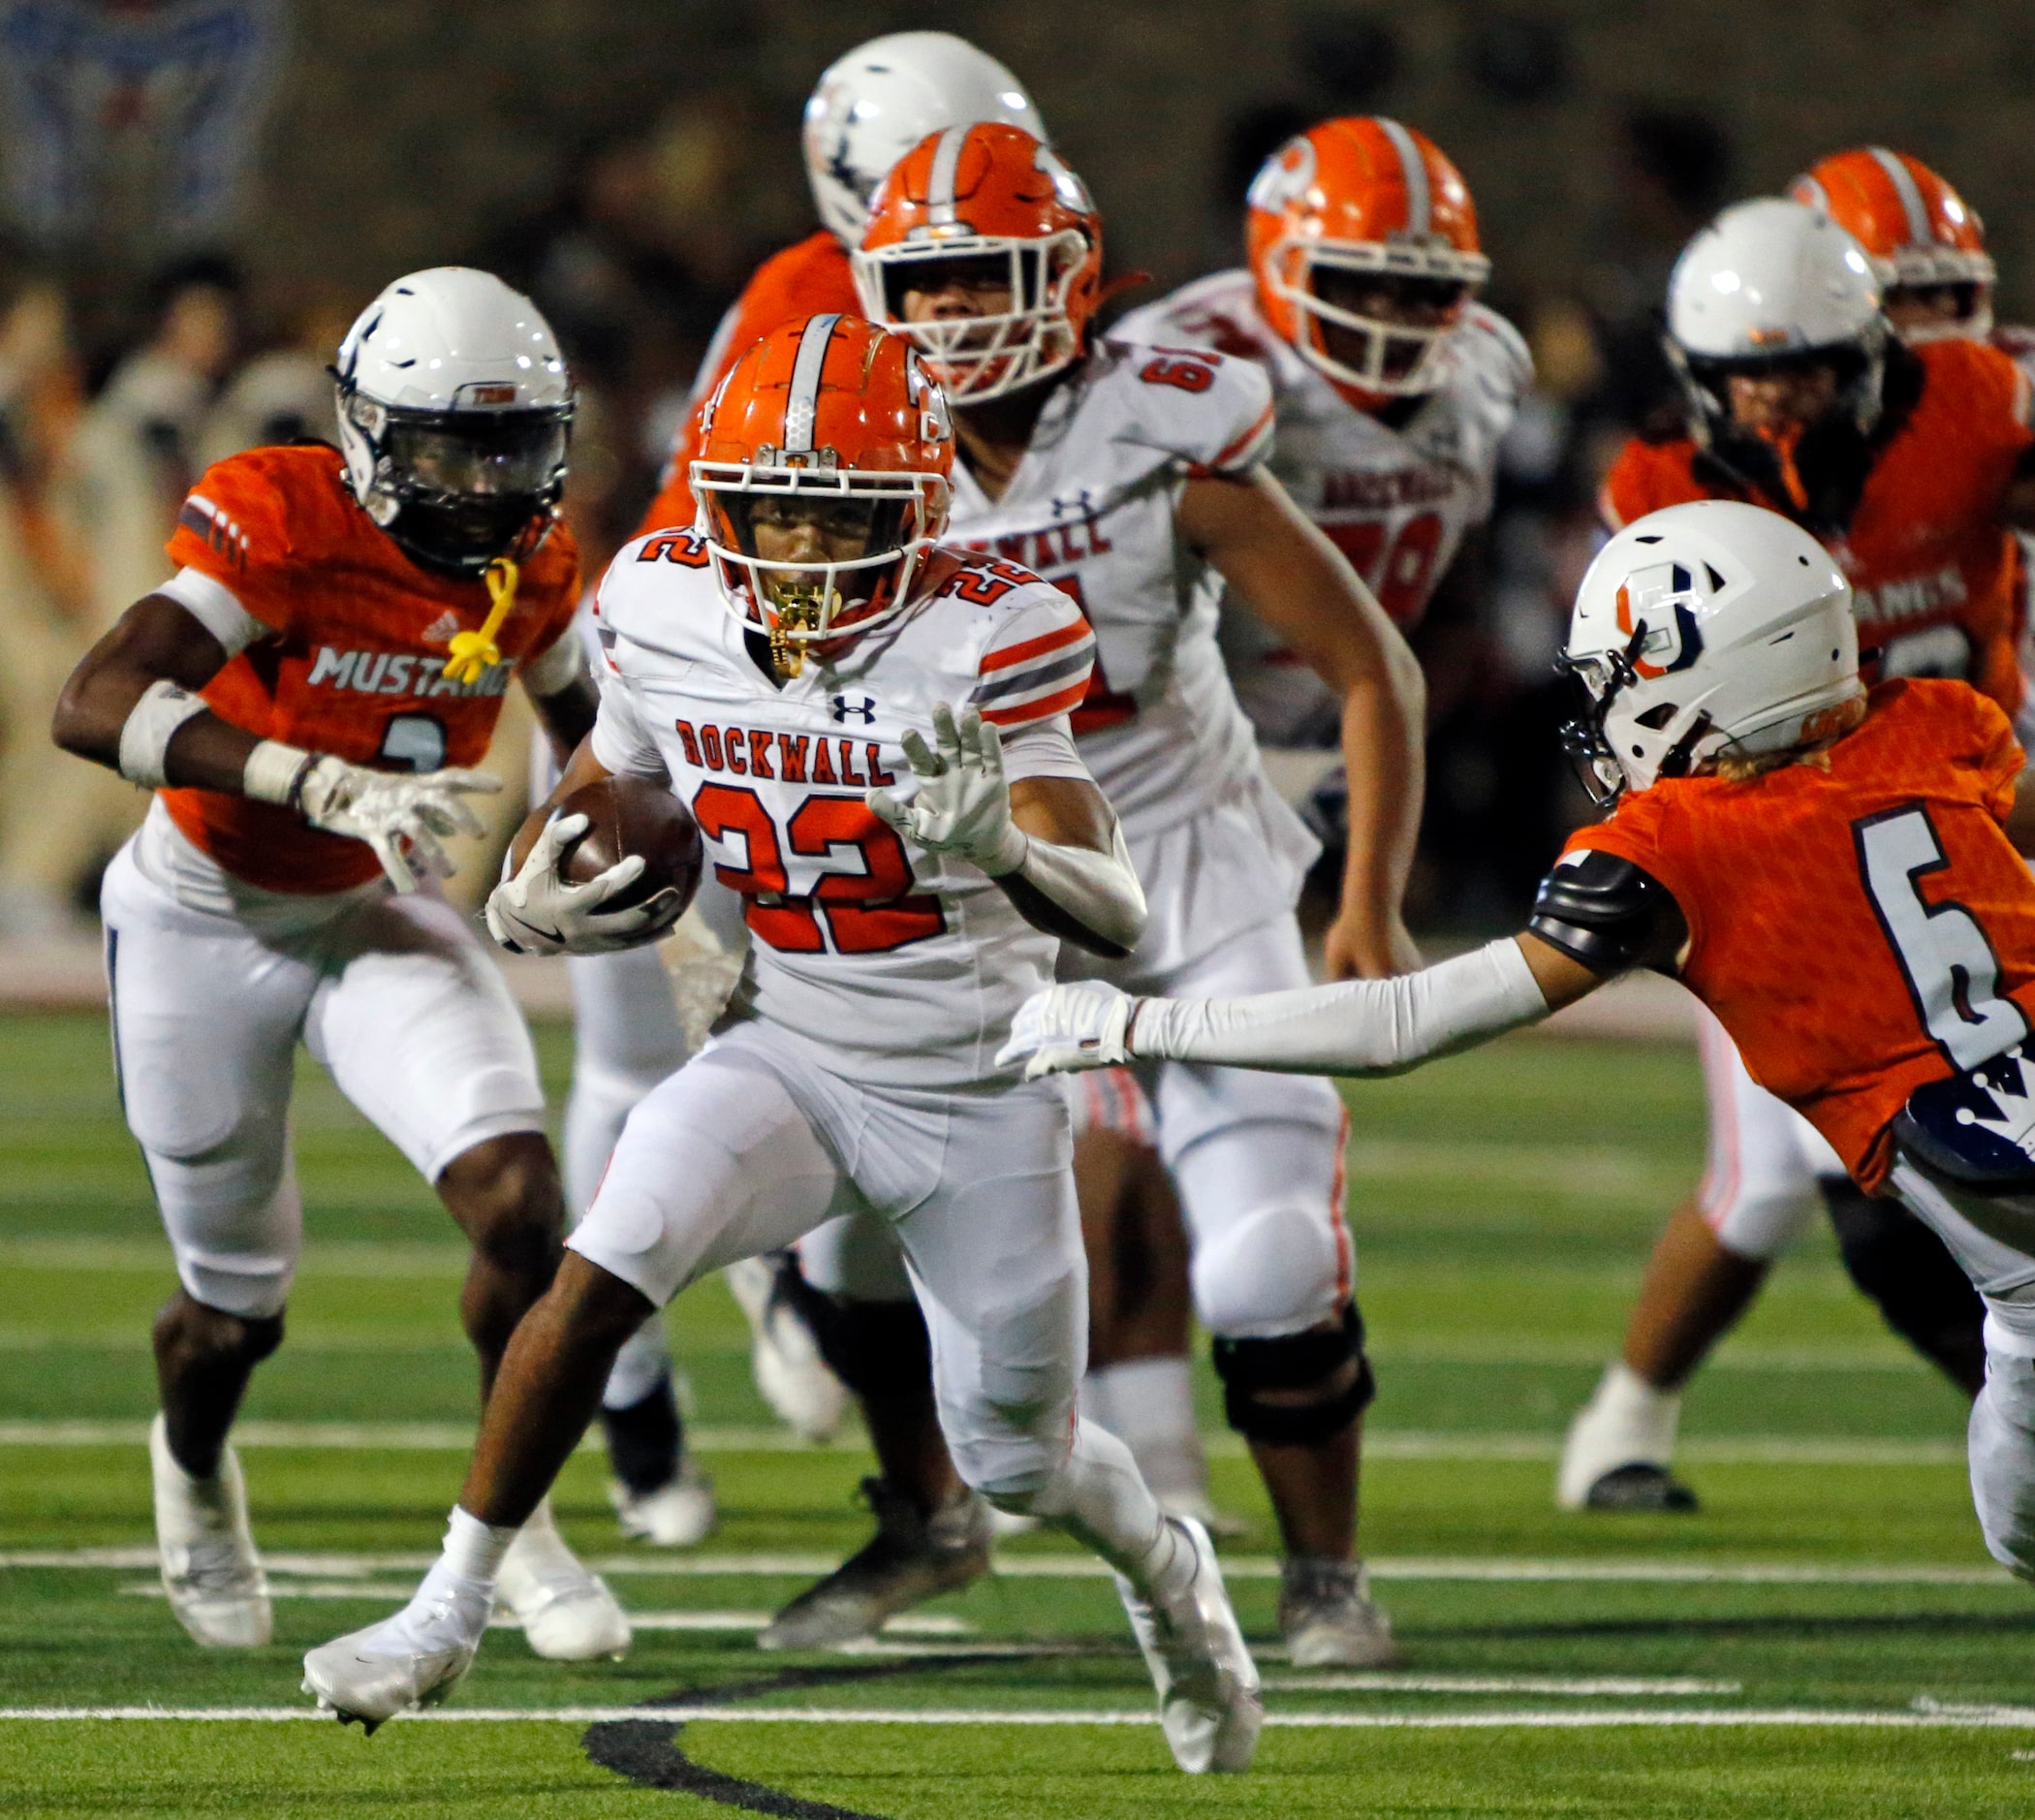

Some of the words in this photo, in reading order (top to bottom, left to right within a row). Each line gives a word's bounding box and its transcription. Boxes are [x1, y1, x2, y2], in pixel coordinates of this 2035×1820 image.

[675, 719, 896, 787] ROCKWALL
[692, 780, 948, 955] 22
[1851, 800, 2031, 1074] 6
